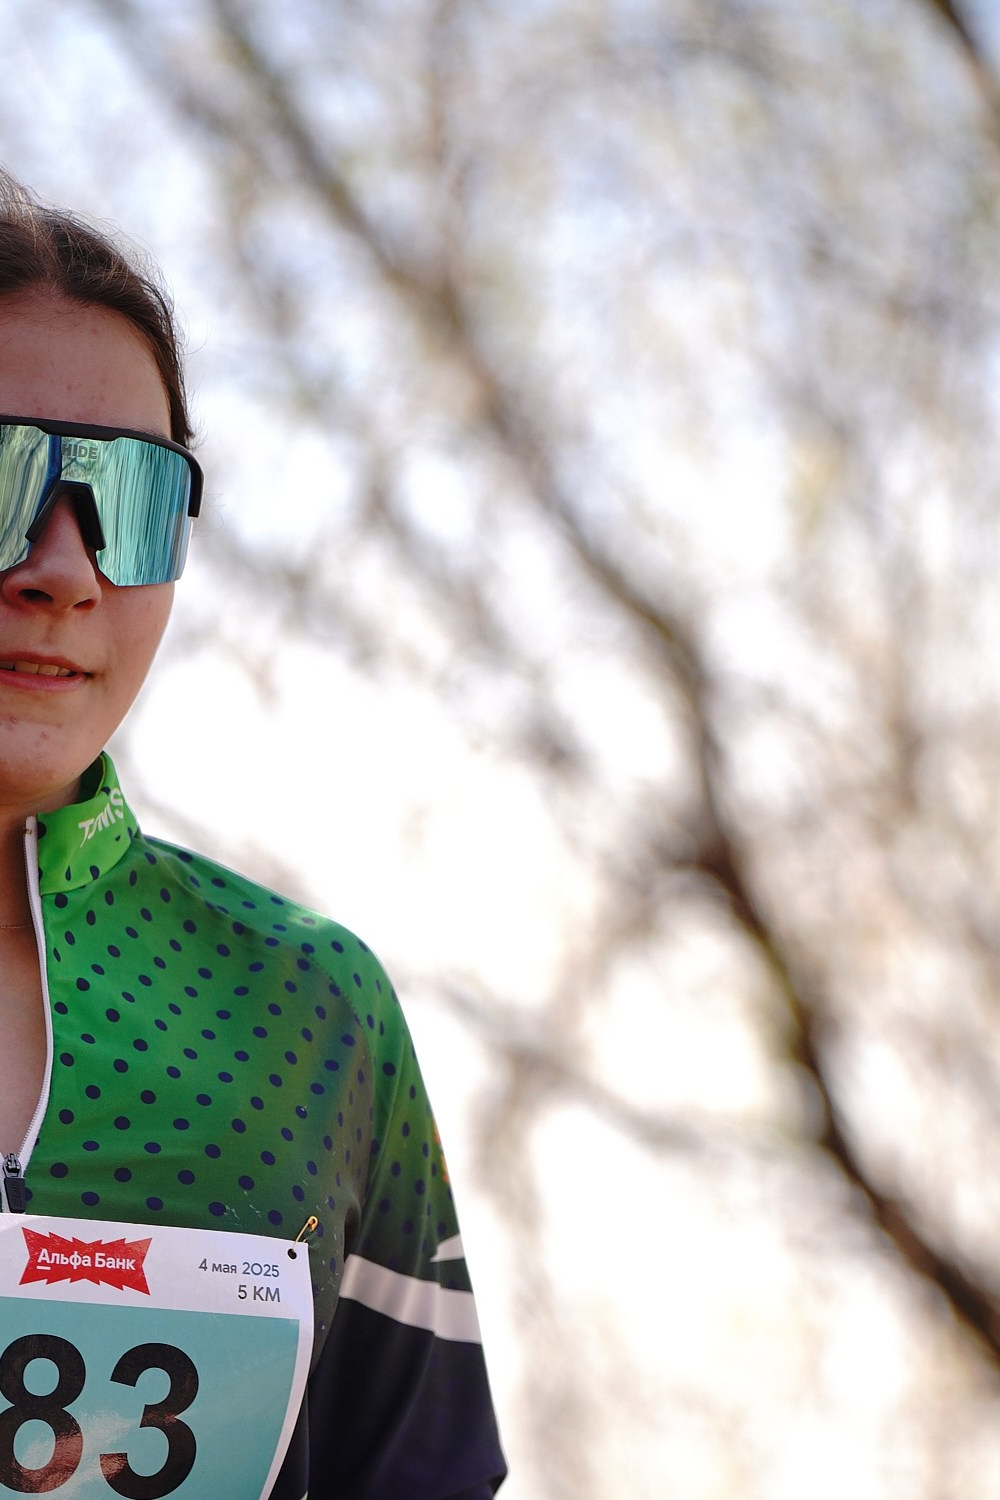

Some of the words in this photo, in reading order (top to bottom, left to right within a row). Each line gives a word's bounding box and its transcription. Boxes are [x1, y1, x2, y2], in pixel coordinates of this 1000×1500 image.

[36, 1248, 92, 1270] Альфа
[94, 1252, 136, 1271] Банк
[198, 1258, 208, 1272] 4
[211, 1262, 238, 1274] мая
[242, 1261, 281, 1278] 2025
[237, 1285, 248, 1300] 5
[253, 1286, 281, 1303] КМ
